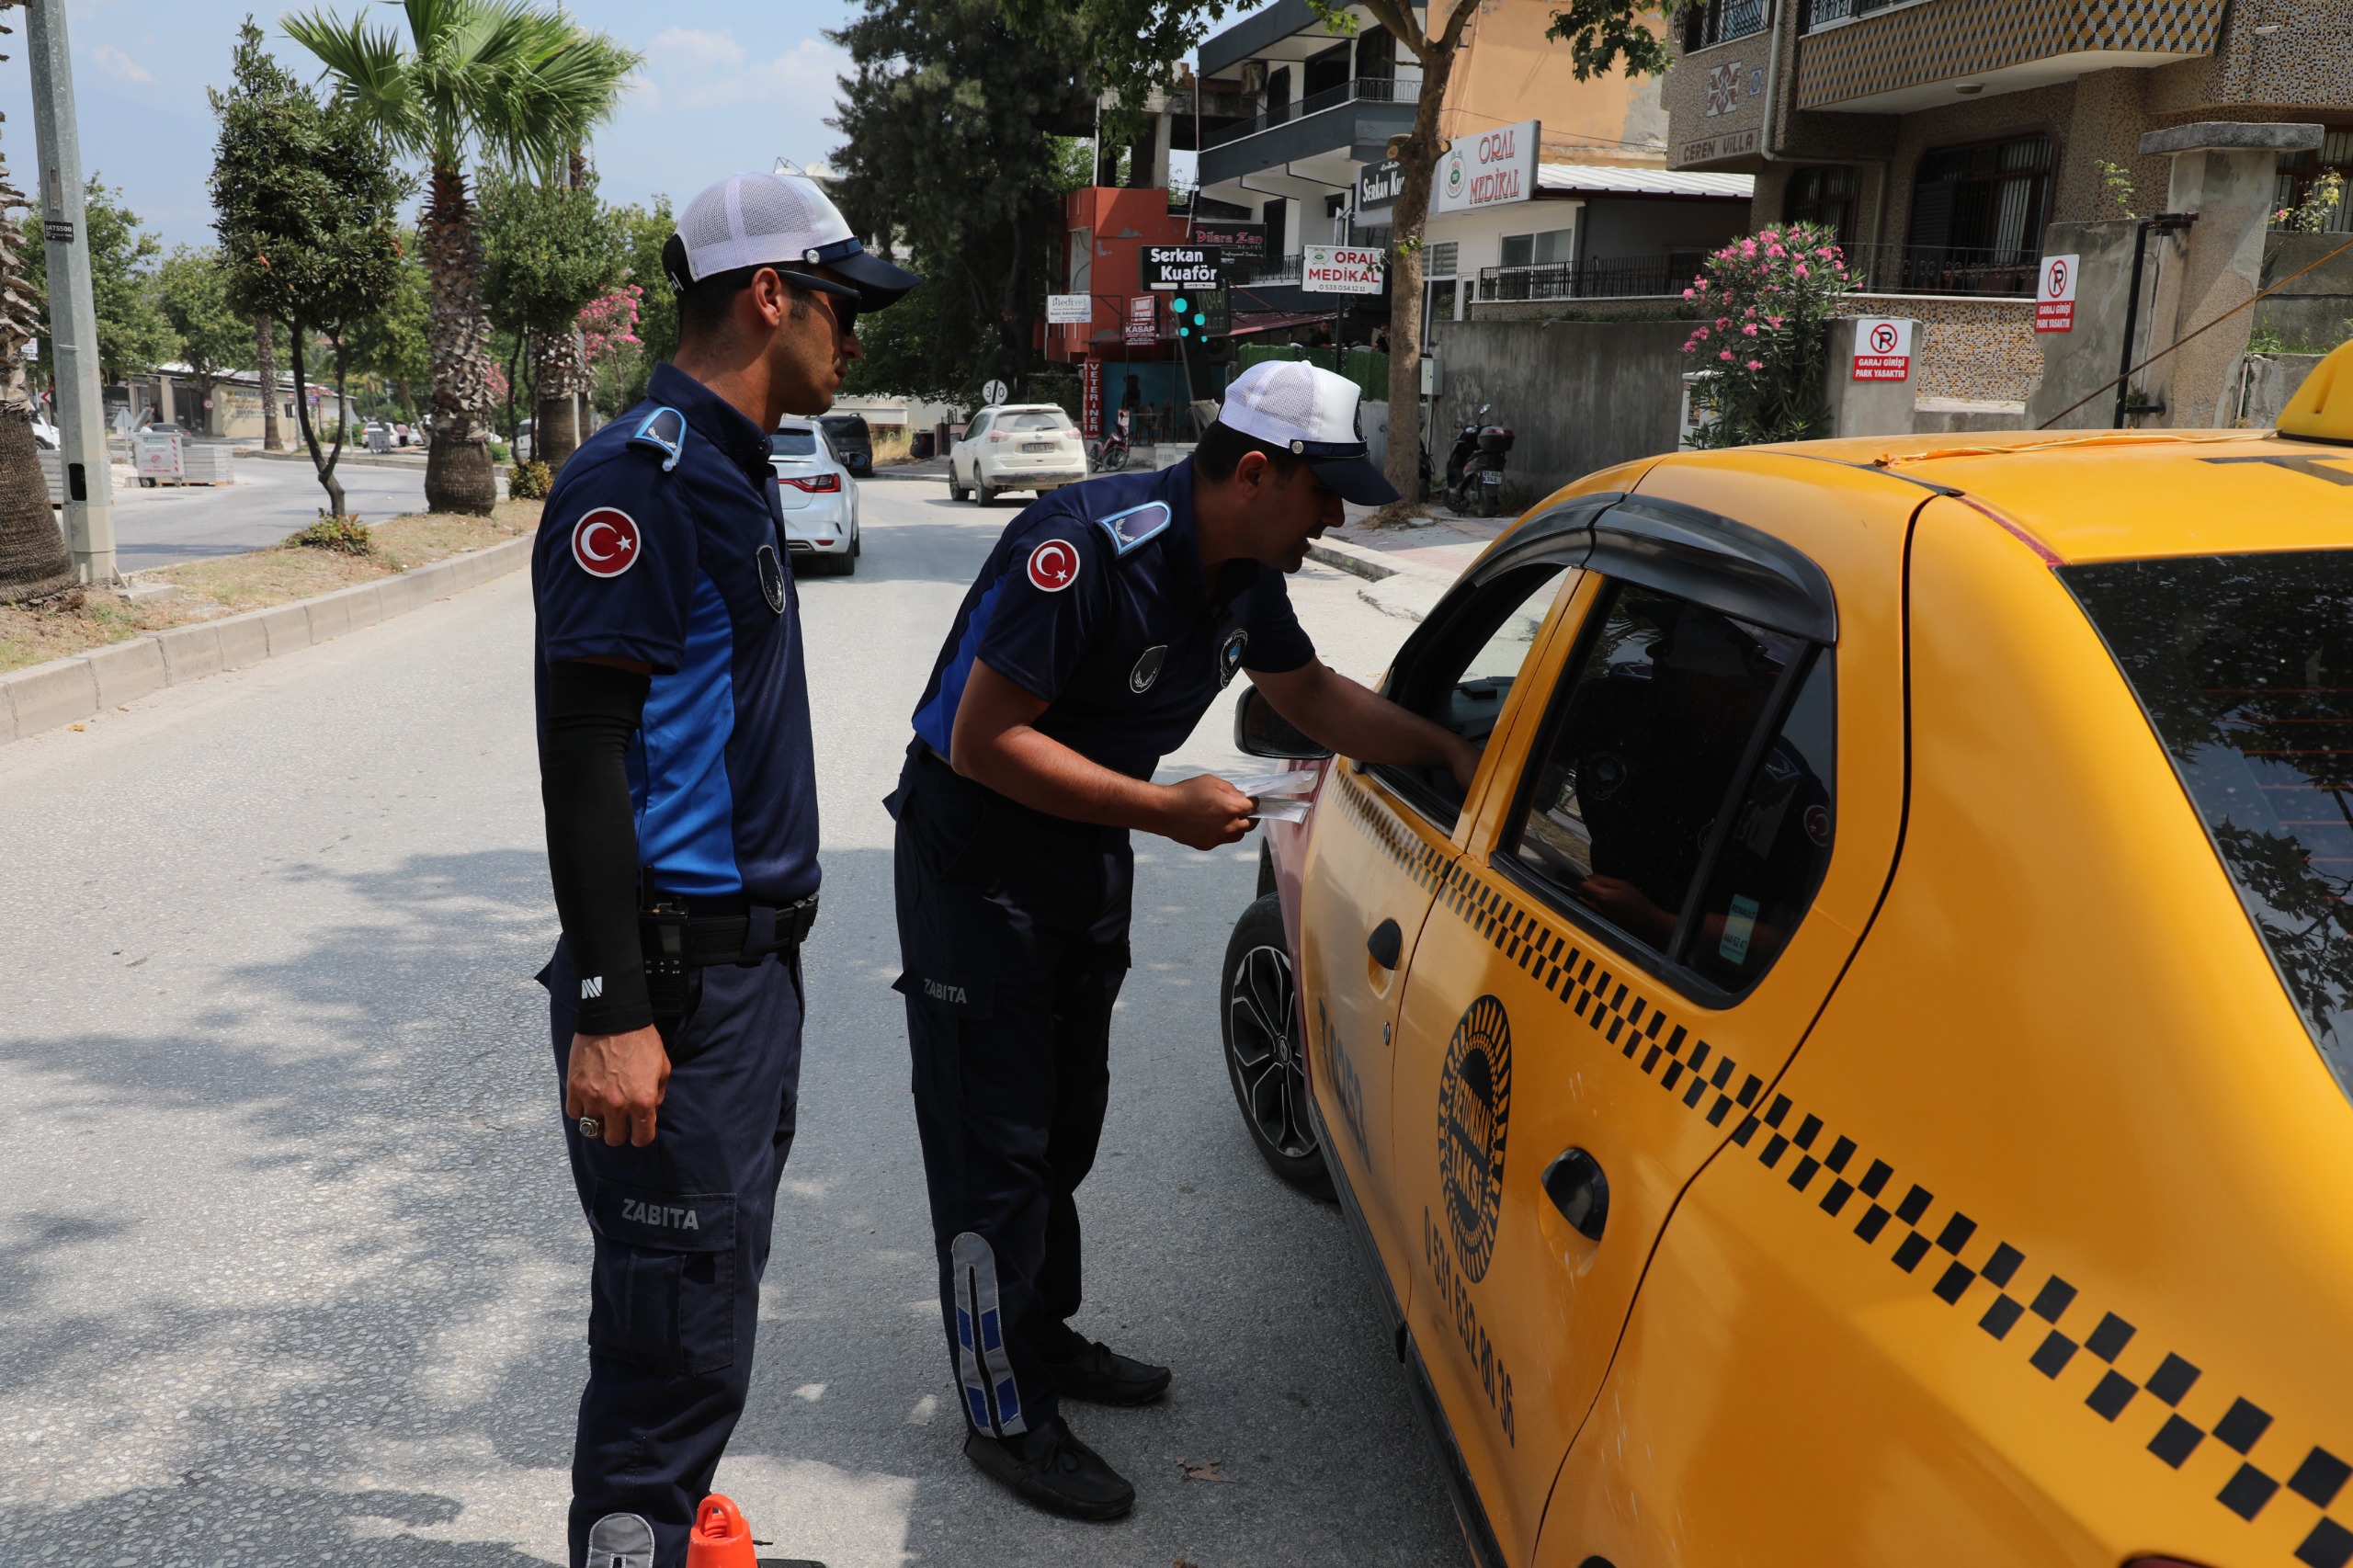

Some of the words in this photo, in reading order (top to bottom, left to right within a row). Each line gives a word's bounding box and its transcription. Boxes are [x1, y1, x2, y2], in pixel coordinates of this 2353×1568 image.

[1479, 131, 1515, 165] ORAL
[1683, 140, 1716, 163] CEREN
[1470, 168, 1519, 204] MEDİKAL
[1195, 230, 1233, 244] Dilara
[1151, 248, 1203, 263] Serkan
[1335, 251, 1379, 265] ORAL
[1161, 265, 1218, 281] Kuaför
[1308, 267, 1381, 283] MEDİKAL
[2039, 304, 2056, 314] GARAJ
[2055, 302, 2072, 316] GİRİŞİ
[2036, 319, 2049, 328] PARK
[2049, 318, 2071, 328] YASAKTIR
[1858, 358, 1882, 367] GARAJ
[1883, 357, 1905, 369] GİRİŞİ
[1855, 369, 1873, 378] PARK
[1874, 369, 1905, 378] YASAKTIR
[1089, 363, 1099, 431] VETERİNER
[924, 978, 967, 1004] ZABITA
[1452, 1074, 1492, 1160] BETONSAN
[1451, 1133, 1483, 1217] TAKSİ
[621, 1198, 699, 1230] ZABITA
[1425, 1205, 1431, 1267] 0
[1434, 1222, 1452, 1316] 531
[1455, 1272, 1478, 1373] 632
[1480, 1325, 1495, 1410] 80
[1498, 1358, 1515, 1449] 36
